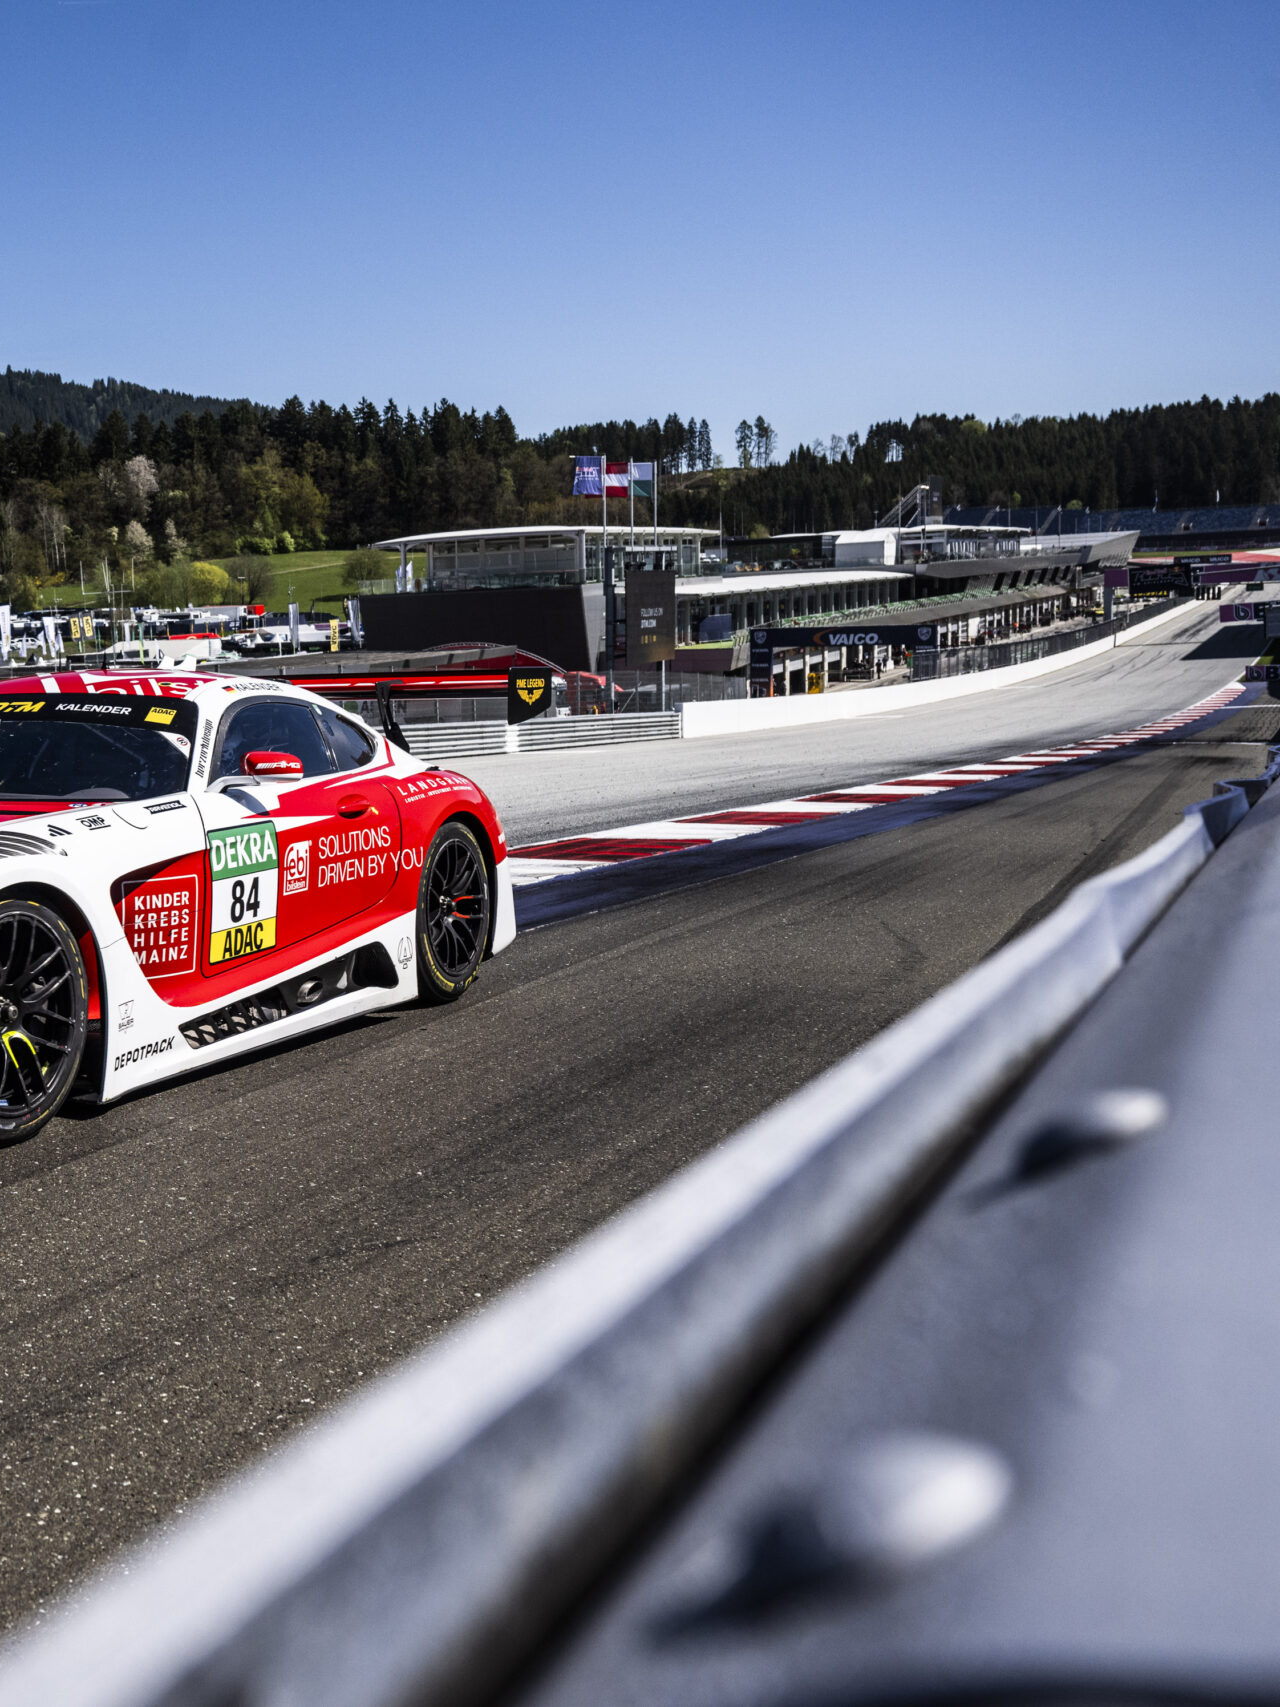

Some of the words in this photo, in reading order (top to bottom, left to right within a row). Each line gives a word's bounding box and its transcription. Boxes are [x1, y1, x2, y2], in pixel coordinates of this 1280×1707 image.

[829, 633, 879, 645] VAICO
[233, 682, 283, 691] KALENDER
[527, 679, 545, 687] LEGEND
[55, 703, 132, 715] KALENDER
[151, 707, 175, 716] ADAC
[80, 816, 106, 828] OMP
[211, 830, 277, 872] DEKRA
[319, 826, 391, 859] SOLUTIONS
[318, 857, 364, 887] DRIVEN
[368, 853, 387, 876] BY
[390, 846, 424, 872] YOU
[134, 891, 189, 911] KINDER
[230, 877, 260, 923] 84
[134, 909, 190, 930] KREBS
[133, 927, 189, 948] HILFE
[223, 922, 264, 959] ADAC
[133, 945, 188, 965] MAINZ
[114, 1035, 175, 1072] DEPOTPACK
